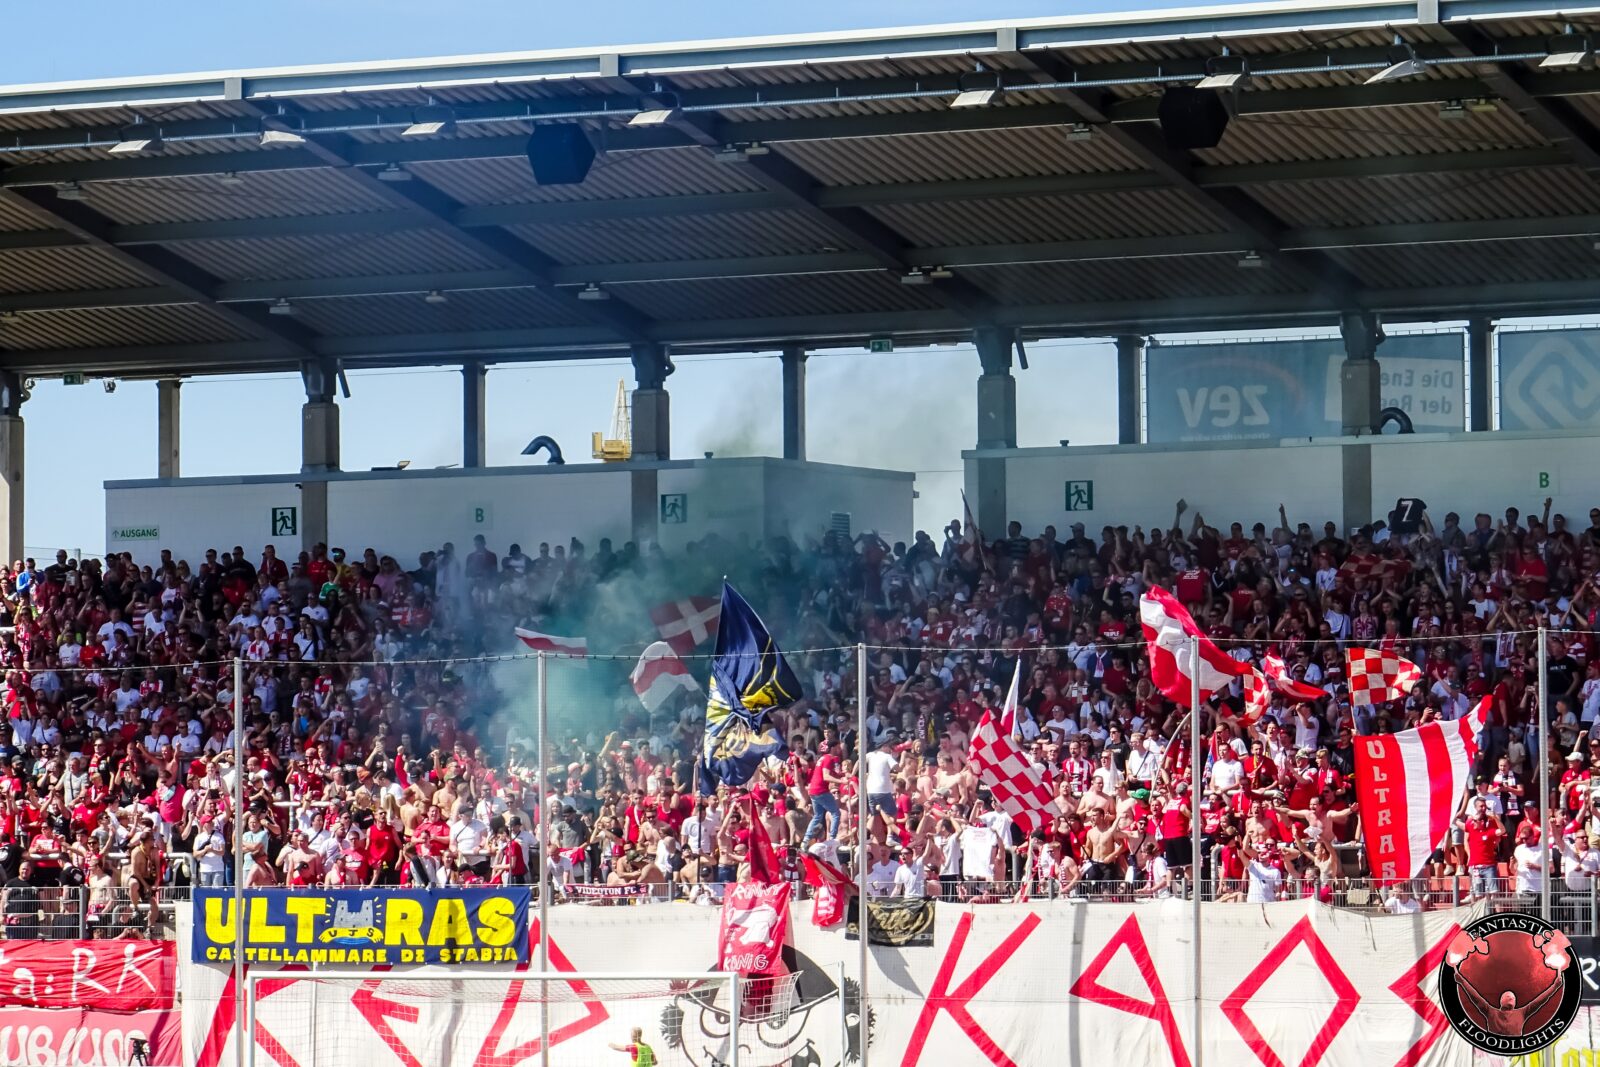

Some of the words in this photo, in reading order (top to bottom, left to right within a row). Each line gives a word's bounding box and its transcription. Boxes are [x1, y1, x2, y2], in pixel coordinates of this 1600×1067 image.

[1539, 471, 1550, 489] B
[475, 507, 484, 523] B
[1401, 500, 1413, 522] 7
[120, 528, 158, 538] AUSGANG
[1366, 739, 1396, 880] ULTRAS
[575, 886, 621, 895] VIDEOTON
[624, 886, 637, 894] FC
[206, 946, 387, 963] CATELLAMMARE
[401, 949, 425, 962] DI
[439, 947, 518, 963] STABIA
